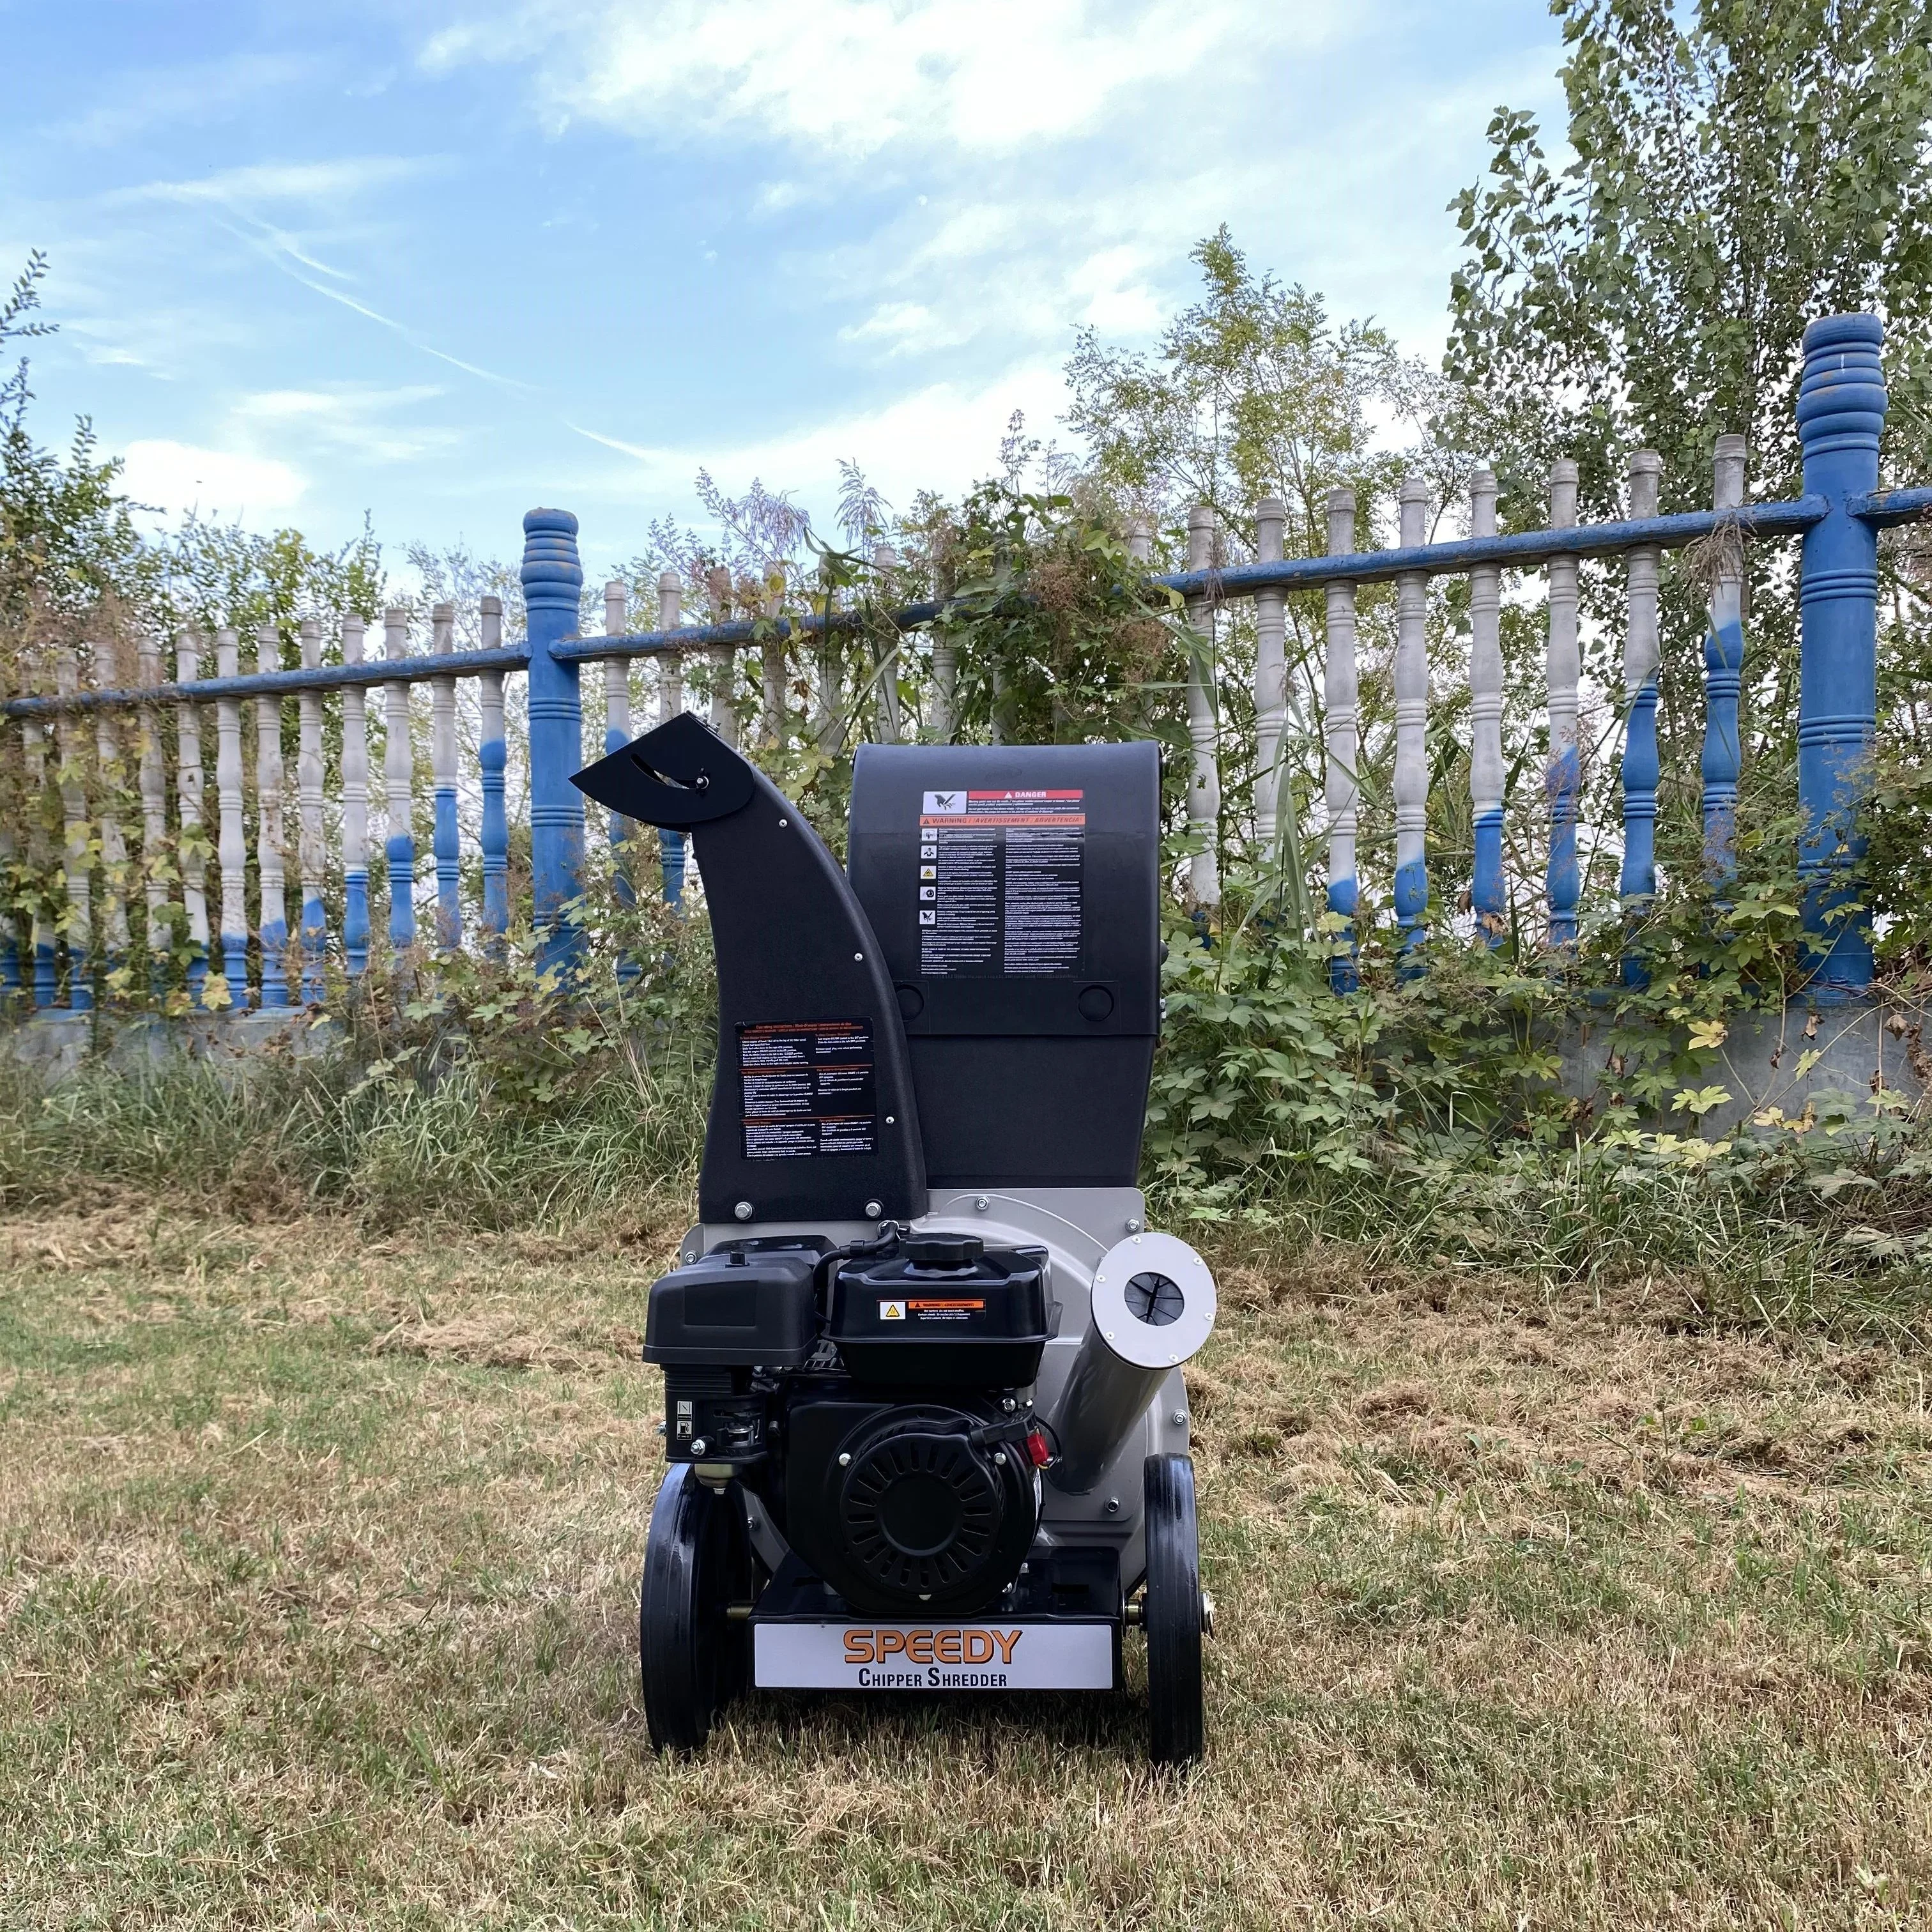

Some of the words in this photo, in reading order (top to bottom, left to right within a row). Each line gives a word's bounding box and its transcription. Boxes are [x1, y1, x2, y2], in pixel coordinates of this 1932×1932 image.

[843, 1630, 1023, 1664] SPEEDY
[859, 1667, 923, 1687] CHIPPER
[928, 1667, 1008, 1687] SHREDDER
